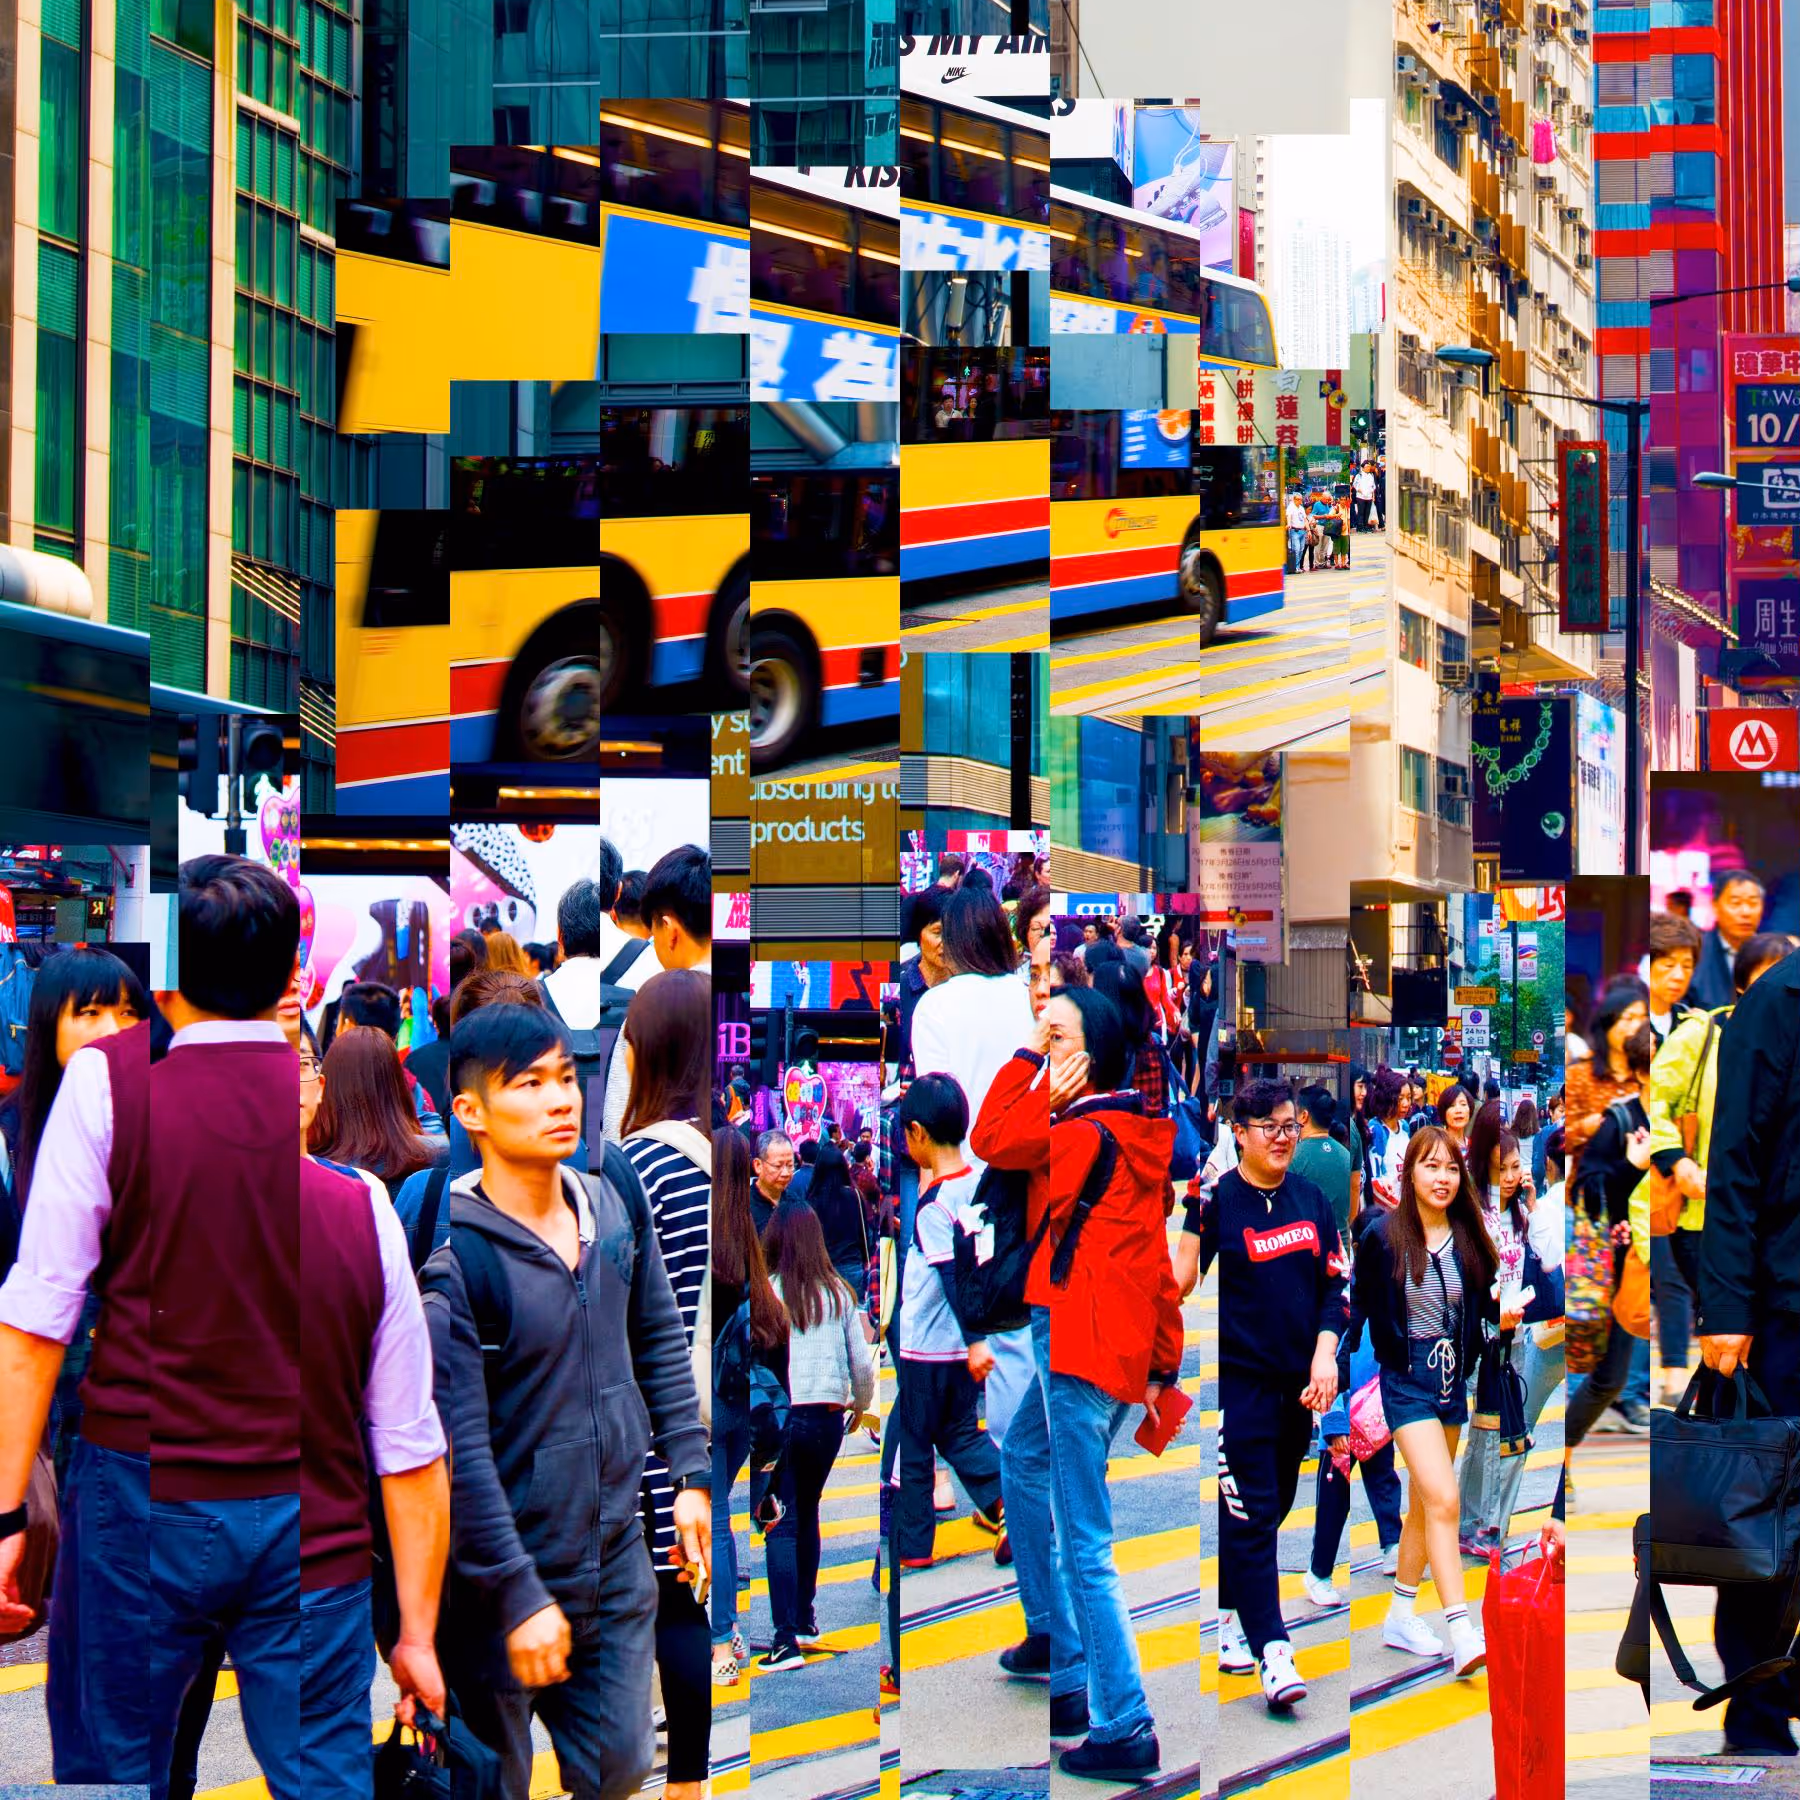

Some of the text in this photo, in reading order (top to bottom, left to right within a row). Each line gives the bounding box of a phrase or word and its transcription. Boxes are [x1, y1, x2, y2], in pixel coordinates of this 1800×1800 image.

[946, 67, 967, 77] NIKE
[751, 816, 865, 848] products
[1253, 1226, 1315, 1254] ROMEO
